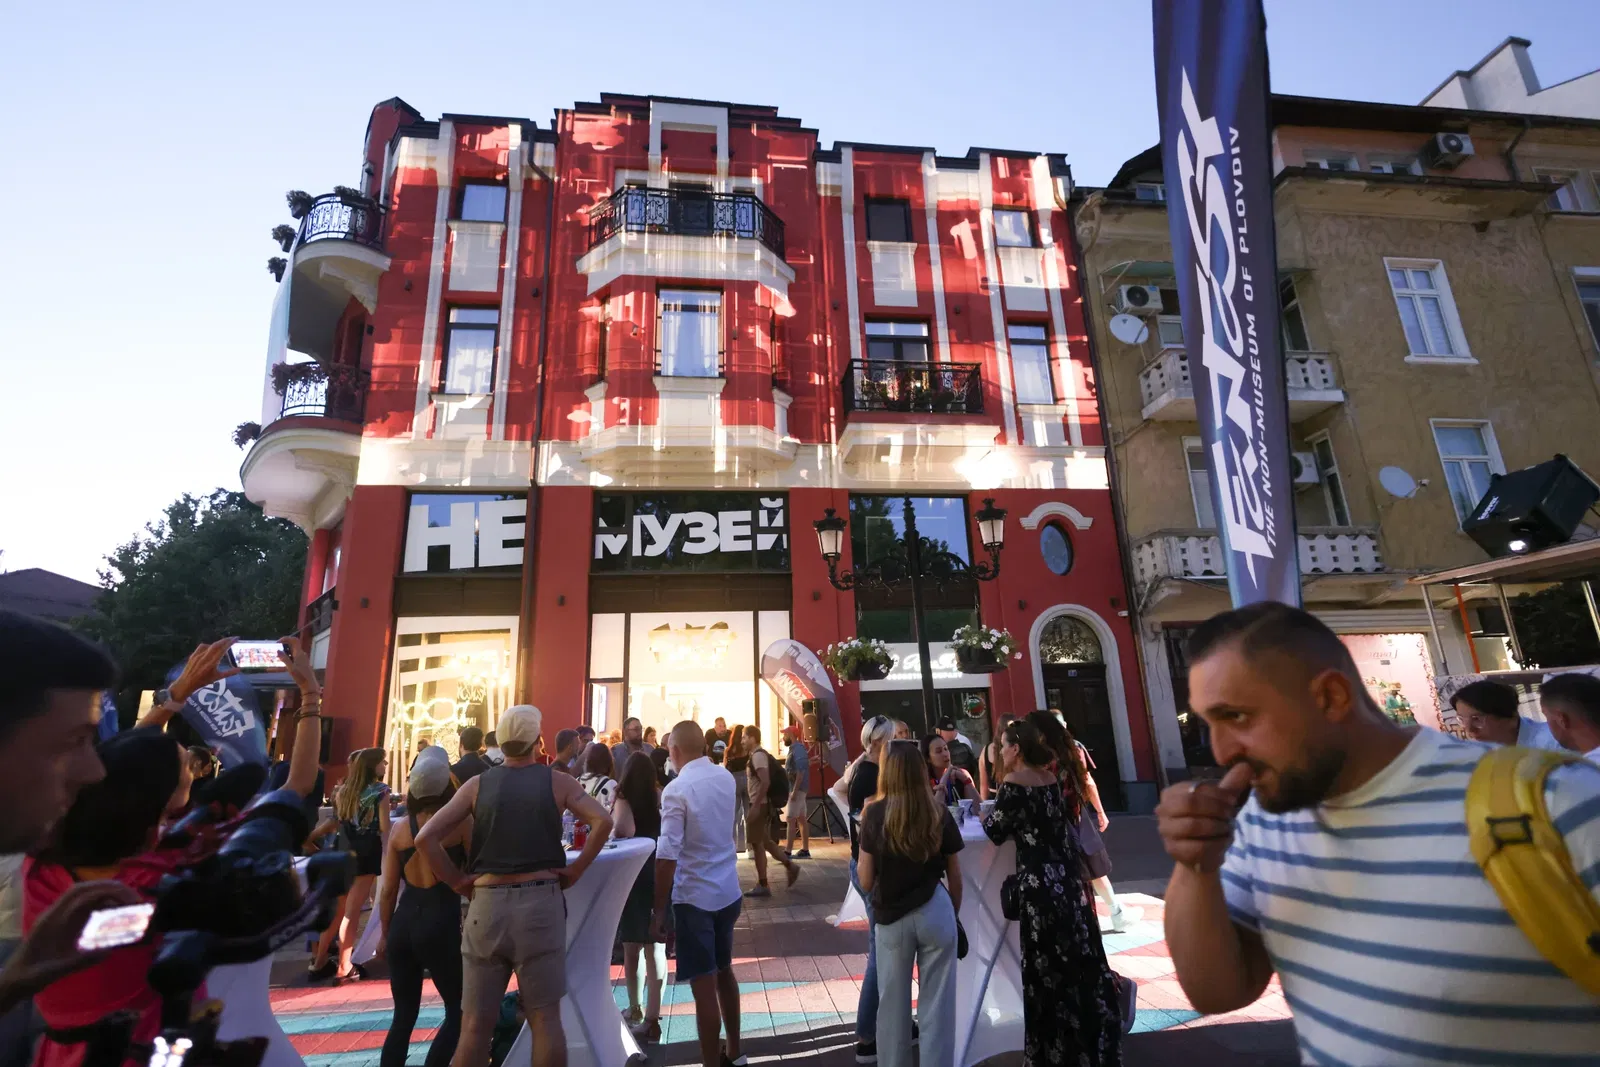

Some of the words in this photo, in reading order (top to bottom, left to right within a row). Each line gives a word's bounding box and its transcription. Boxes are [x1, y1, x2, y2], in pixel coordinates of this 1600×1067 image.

[1229, 126, 1249, 255] PLOVDIV
[1241, 265, 1254, 302] OF
[1246, 313, 1272, 497] NON-MUSEUM
[403, 499, 528, 573] НЕ
[594, 497, 788, 560] МУЗЕЙ
[1264, 500, 1276, 547] THE
